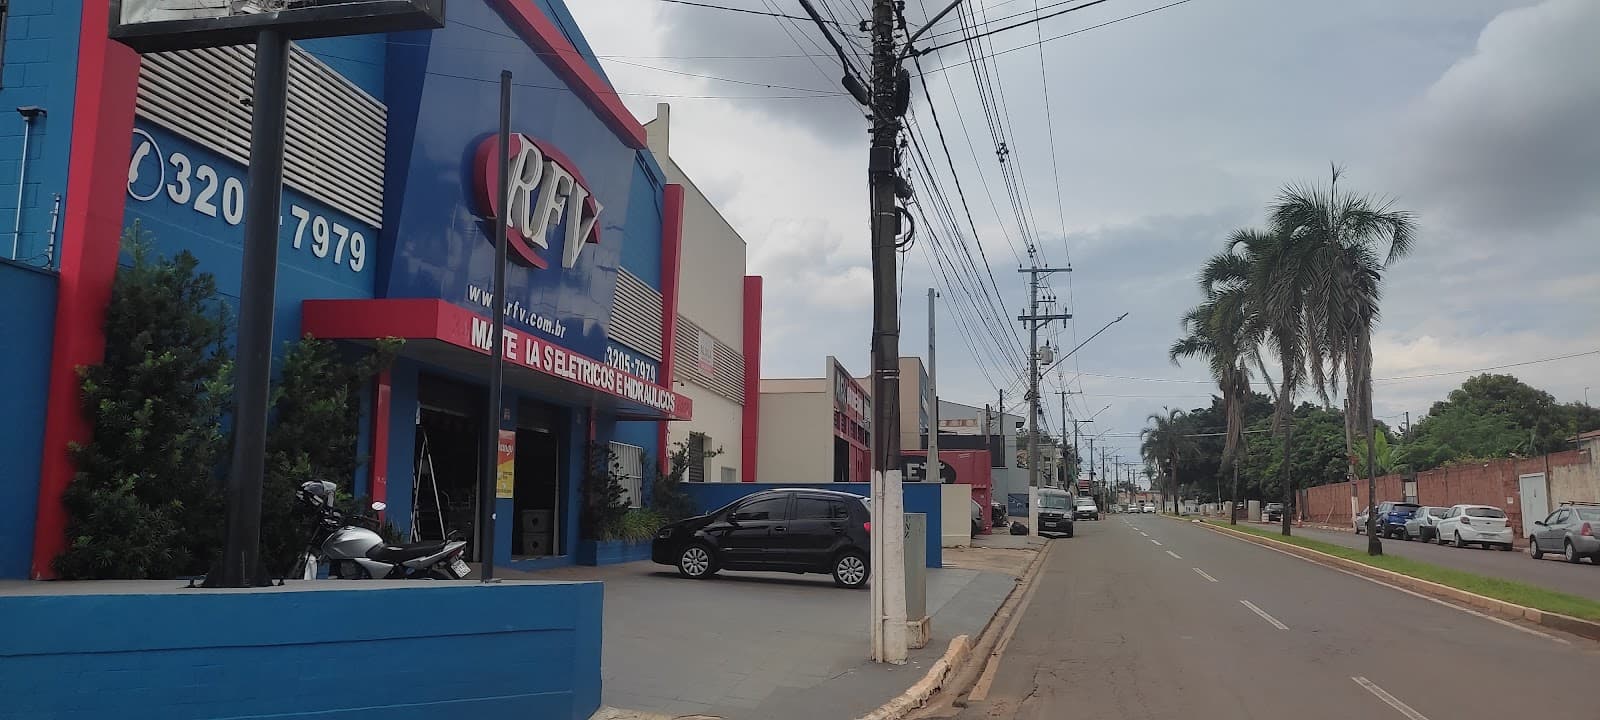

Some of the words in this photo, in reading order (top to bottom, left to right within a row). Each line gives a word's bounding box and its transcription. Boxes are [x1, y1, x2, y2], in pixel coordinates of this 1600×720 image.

[506, 132, 604, 268] RFV
[469, 284, 567, 338] ww.rfv.com.br
[606, 345, 656, 384] 3205-7979
[616, 372, 623, 395] E
[623, 375, 676, 413] HIDRAULICOS
